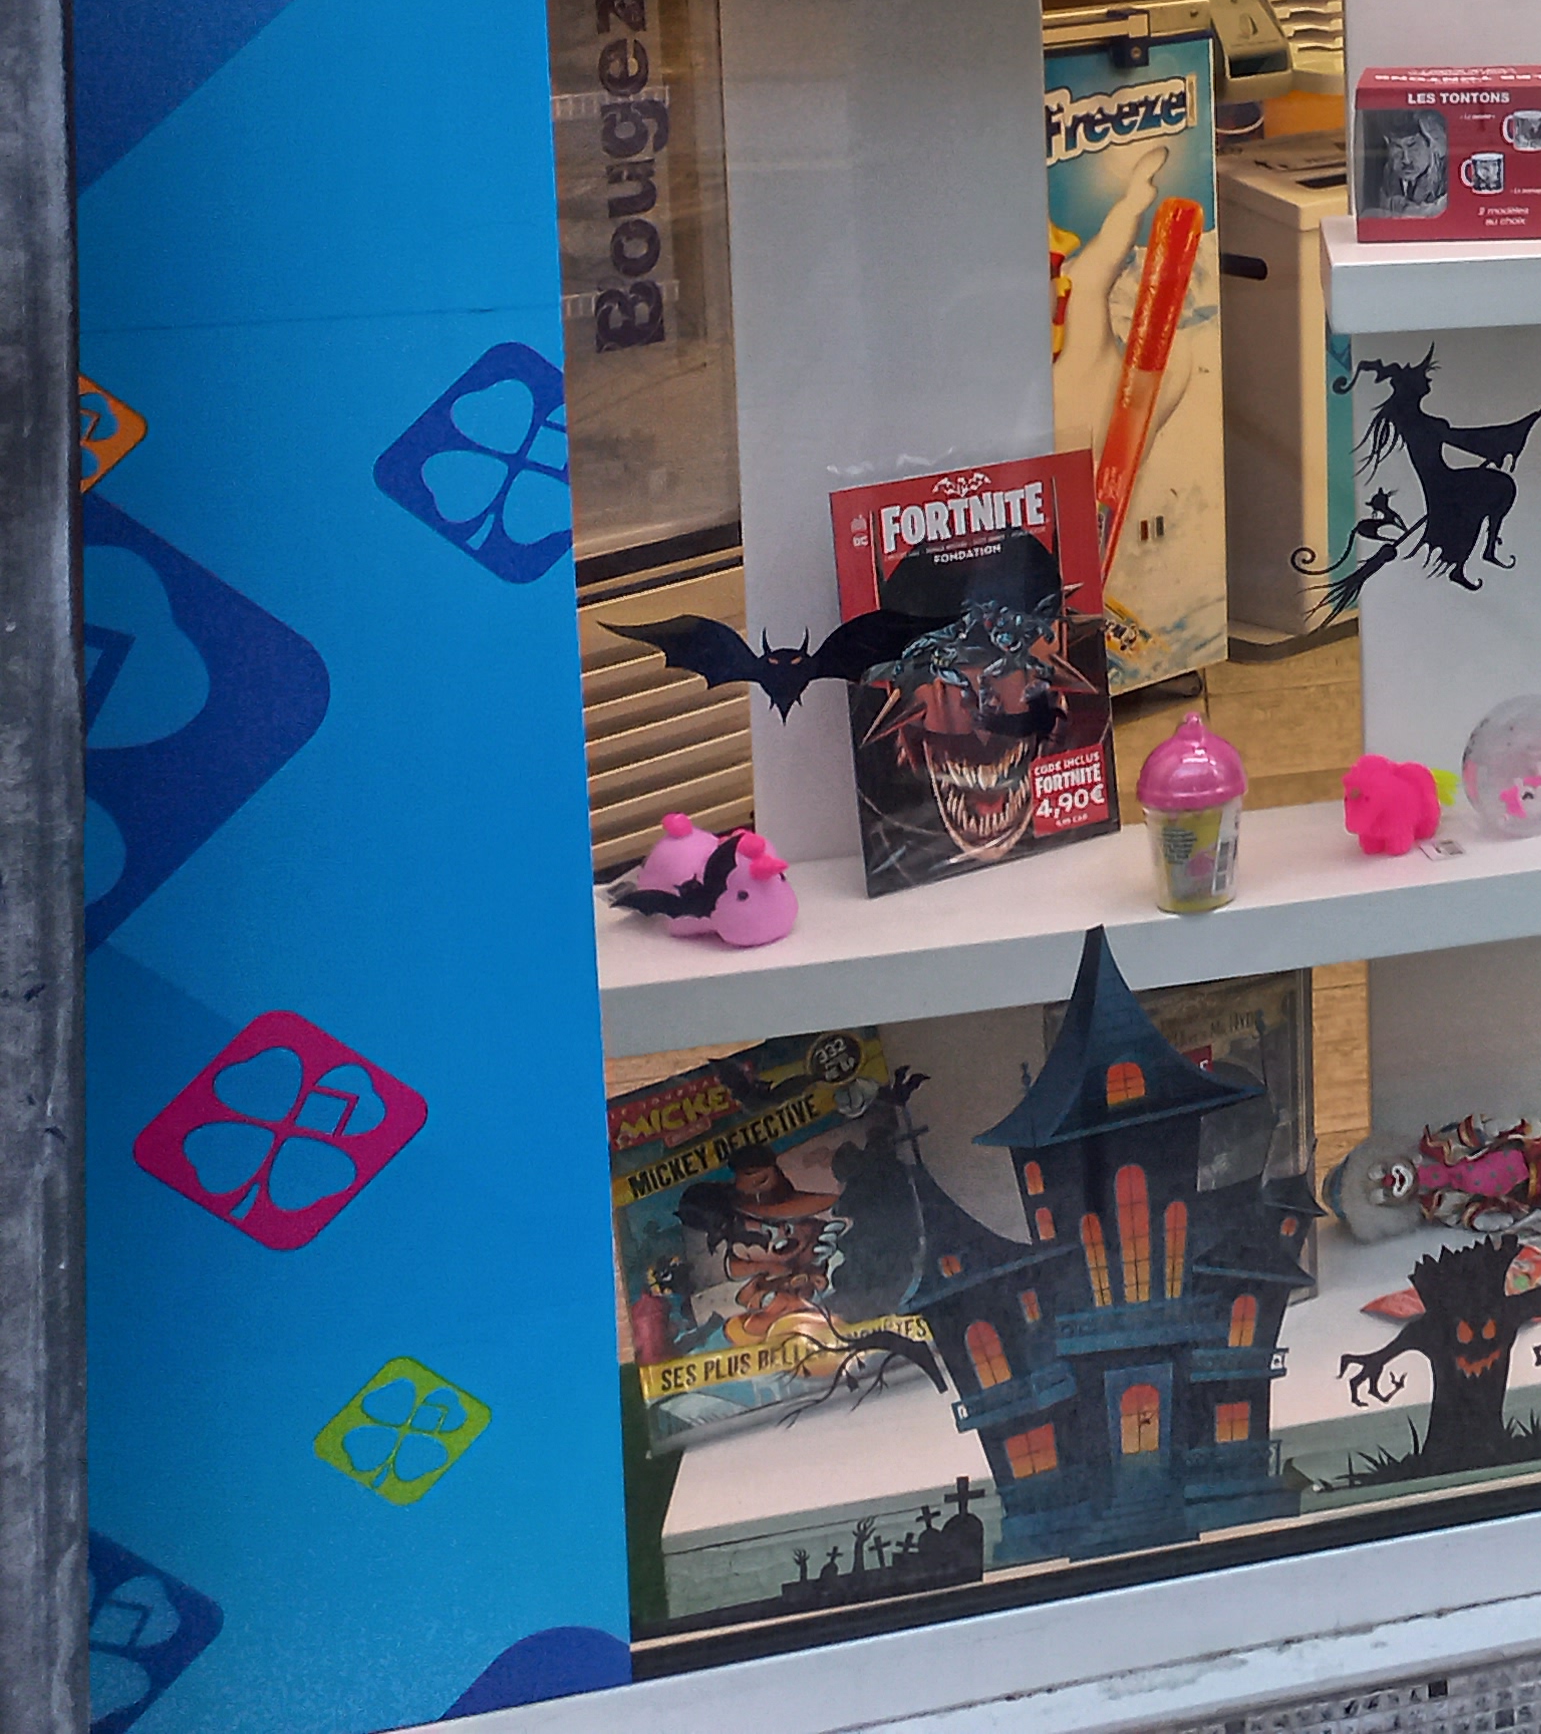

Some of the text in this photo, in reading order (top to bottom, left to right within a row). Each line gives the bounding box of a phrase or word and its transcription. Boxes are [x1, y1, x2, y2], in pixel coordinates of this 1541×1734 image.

[1407, 91, 1511, 105] LES TONTONS
[880, 480, 1046, 553] FORTNITE
[933, 543, 1002, 565] FONDATION
[1034, 765, 1103, 799] FORTNITE
[1035, 784, 1106, 821] 4,90€
[617, 1084, 734, 1139] MICKE
[628, 1144, 715, 1199] MICKEY
[660, 1364, 698, 1392] SES
[703, 1355, 751, 1382] PLUS
